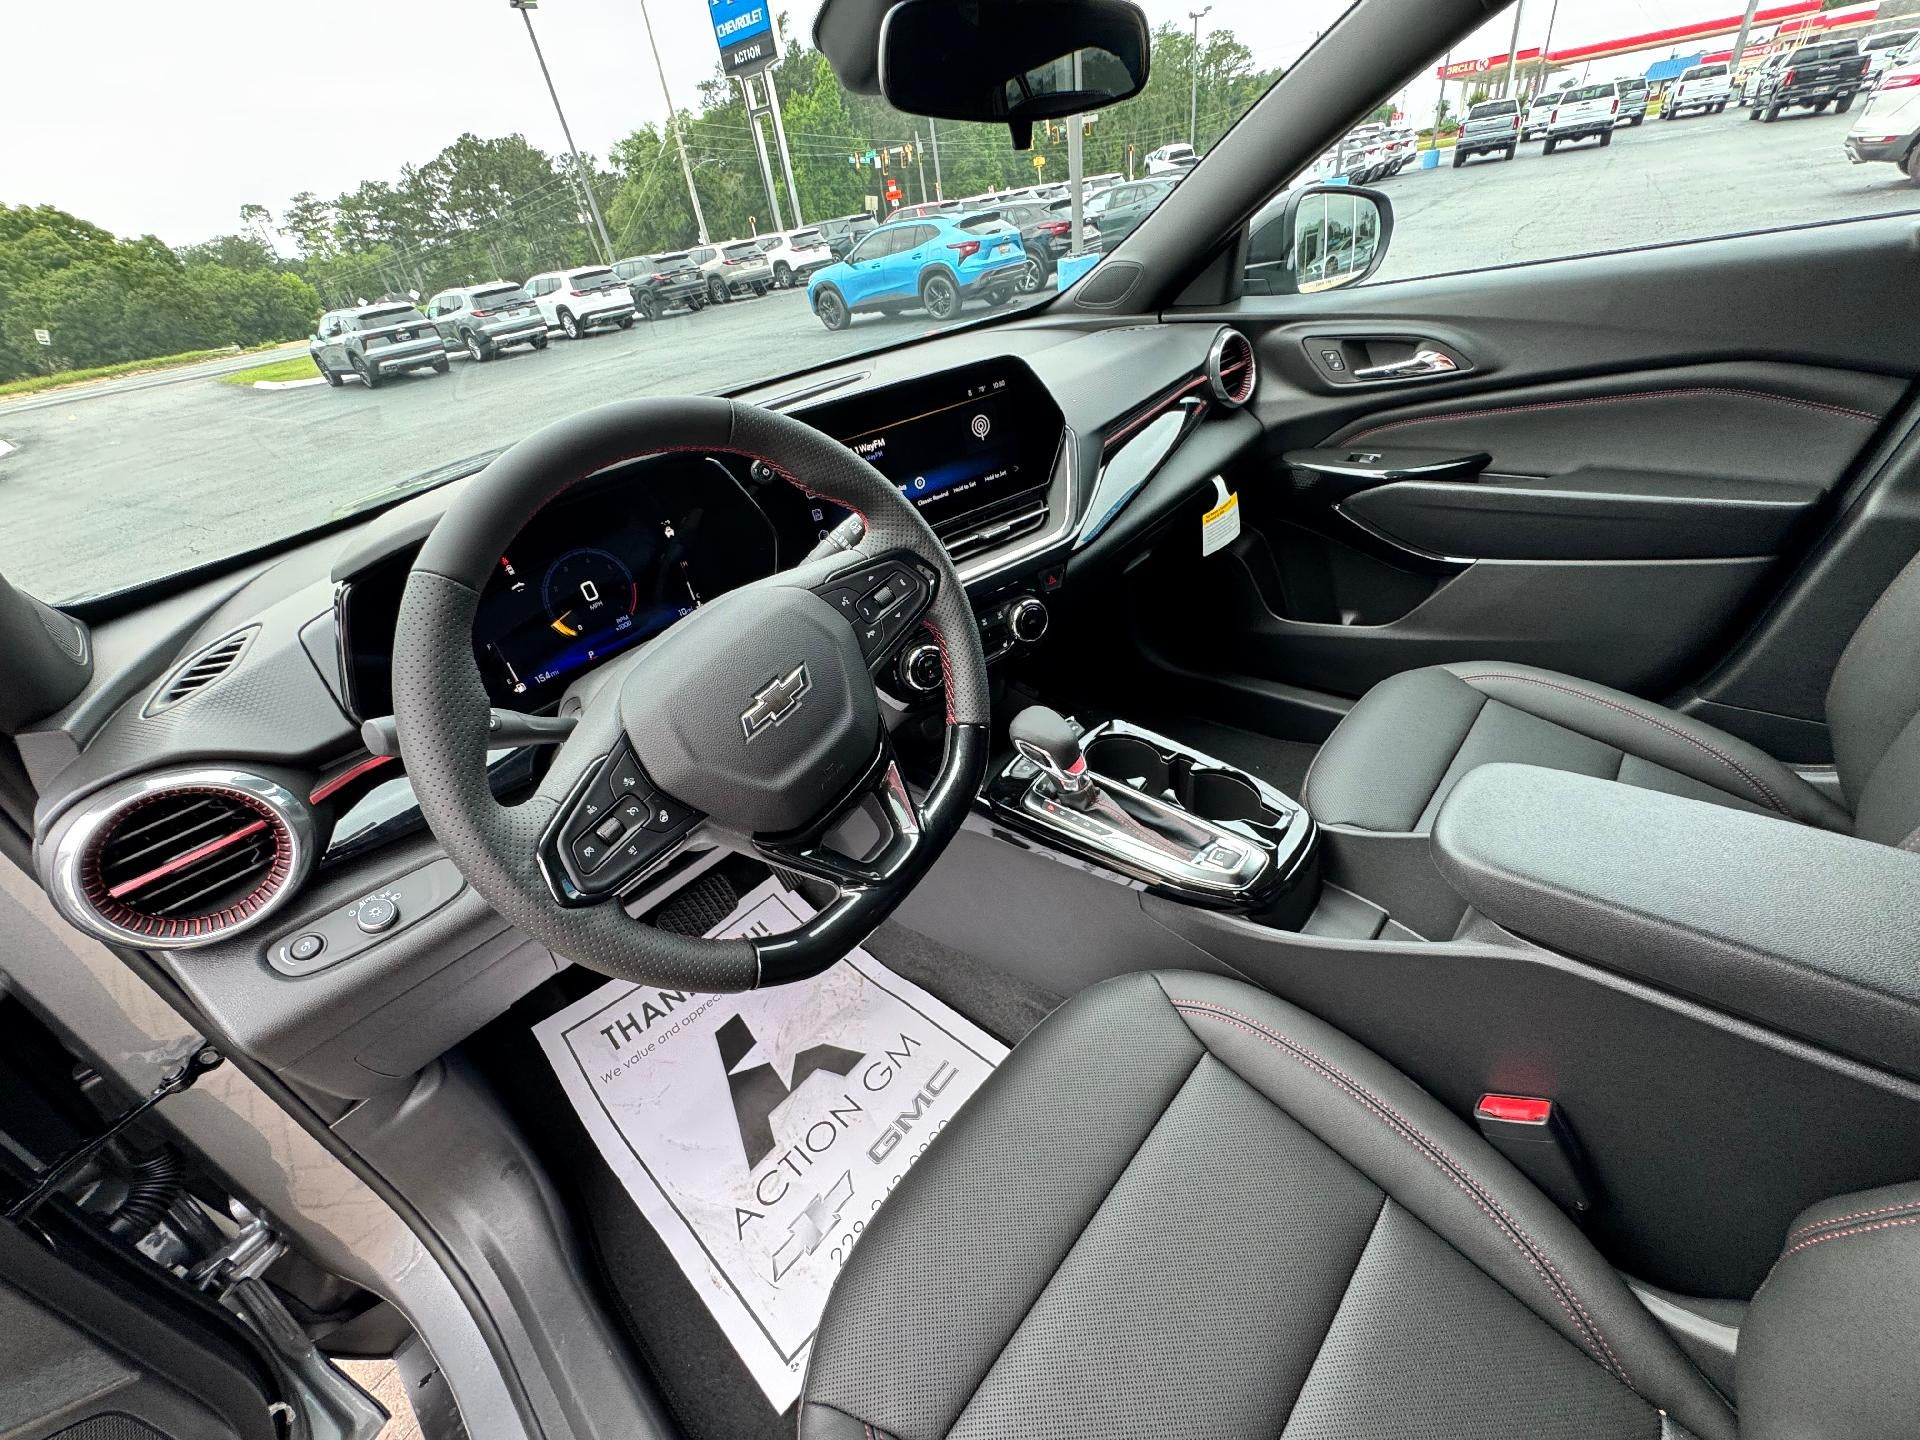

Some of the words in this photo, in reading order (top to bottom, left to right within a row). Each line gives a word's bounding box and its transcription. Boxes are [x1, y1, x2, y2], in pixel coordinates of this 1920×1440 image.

[717, 8, 762, 38] CHEVROLET
[734, 44, 761, 65] ACTION
[859, 437, 886, 453] WayFM
[580, 580, 599, 601] 0
[590, 600, 604, 611] MPH
[616, 614, 630, 624] RPM
[588, 650, 595, 660] P
[600, 991, 696, 1051] THAN
[600, 1065, 622, 1084] We
[623, 1043, 656, 1068] value
[658, 1021, 681, 1045] and
[681, 993, 724, 1026] apprec
[866, 1059, 959, 1166] GMC
[735, 1094, 863, 1241] ACTION
[863, 1033, 921, 1092] GM
